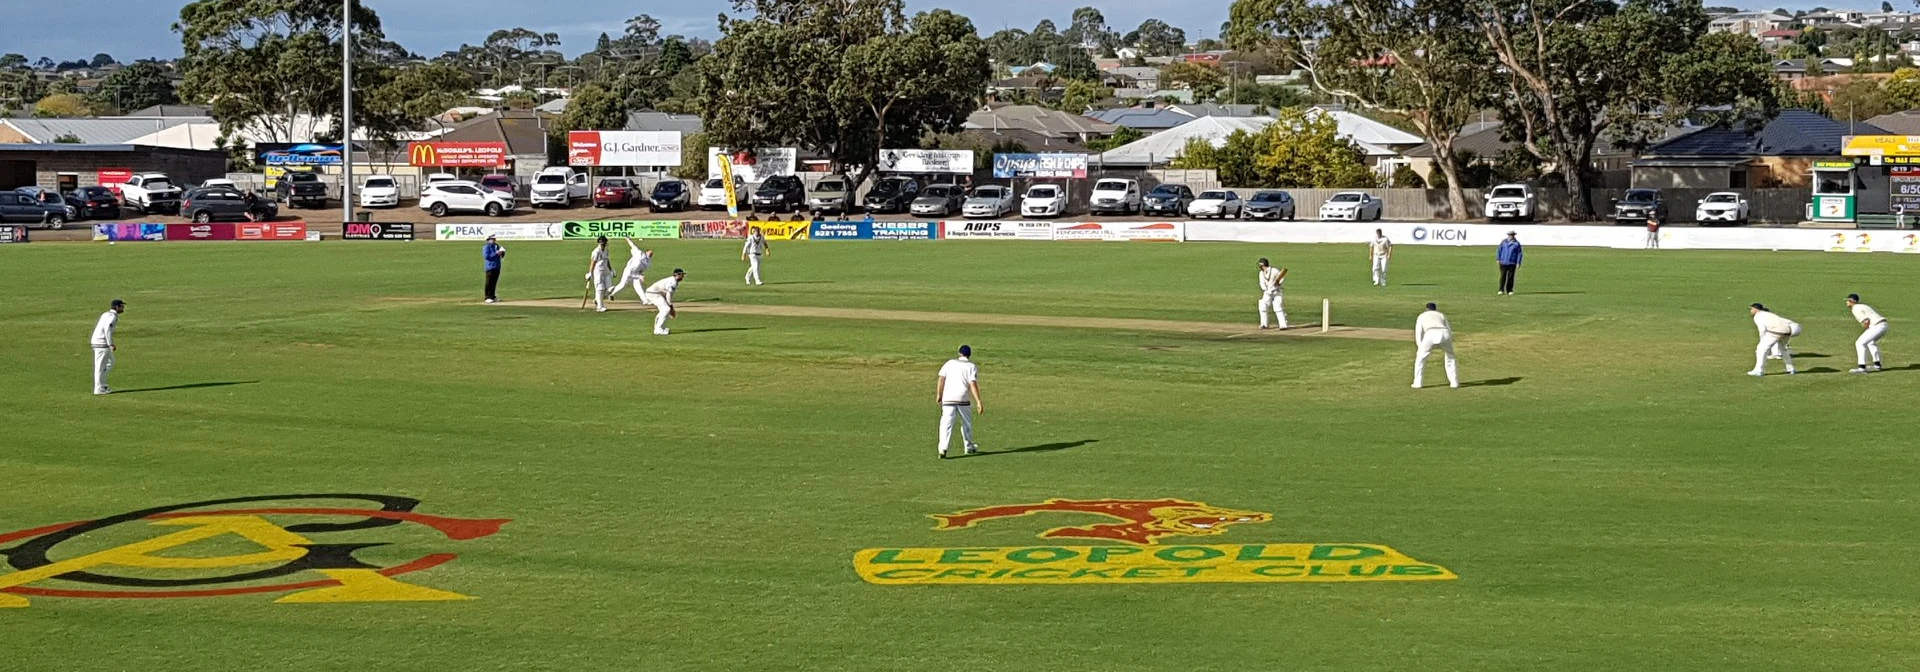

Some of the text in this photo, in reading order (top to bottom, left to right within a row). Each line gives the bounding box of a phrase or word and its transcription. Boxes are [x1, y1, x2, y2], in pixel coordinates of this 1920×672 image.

[346, 223, 370, 234] JDM
[455, 226, 484, 235] PEAK
[588, 221, 634, 231] SURF
[1431, 229, 1467, 240] IKON
[869, 544, 1386, 565] LEOPOLD
[873, 564, 1444, 579] CRICKET CLUB
